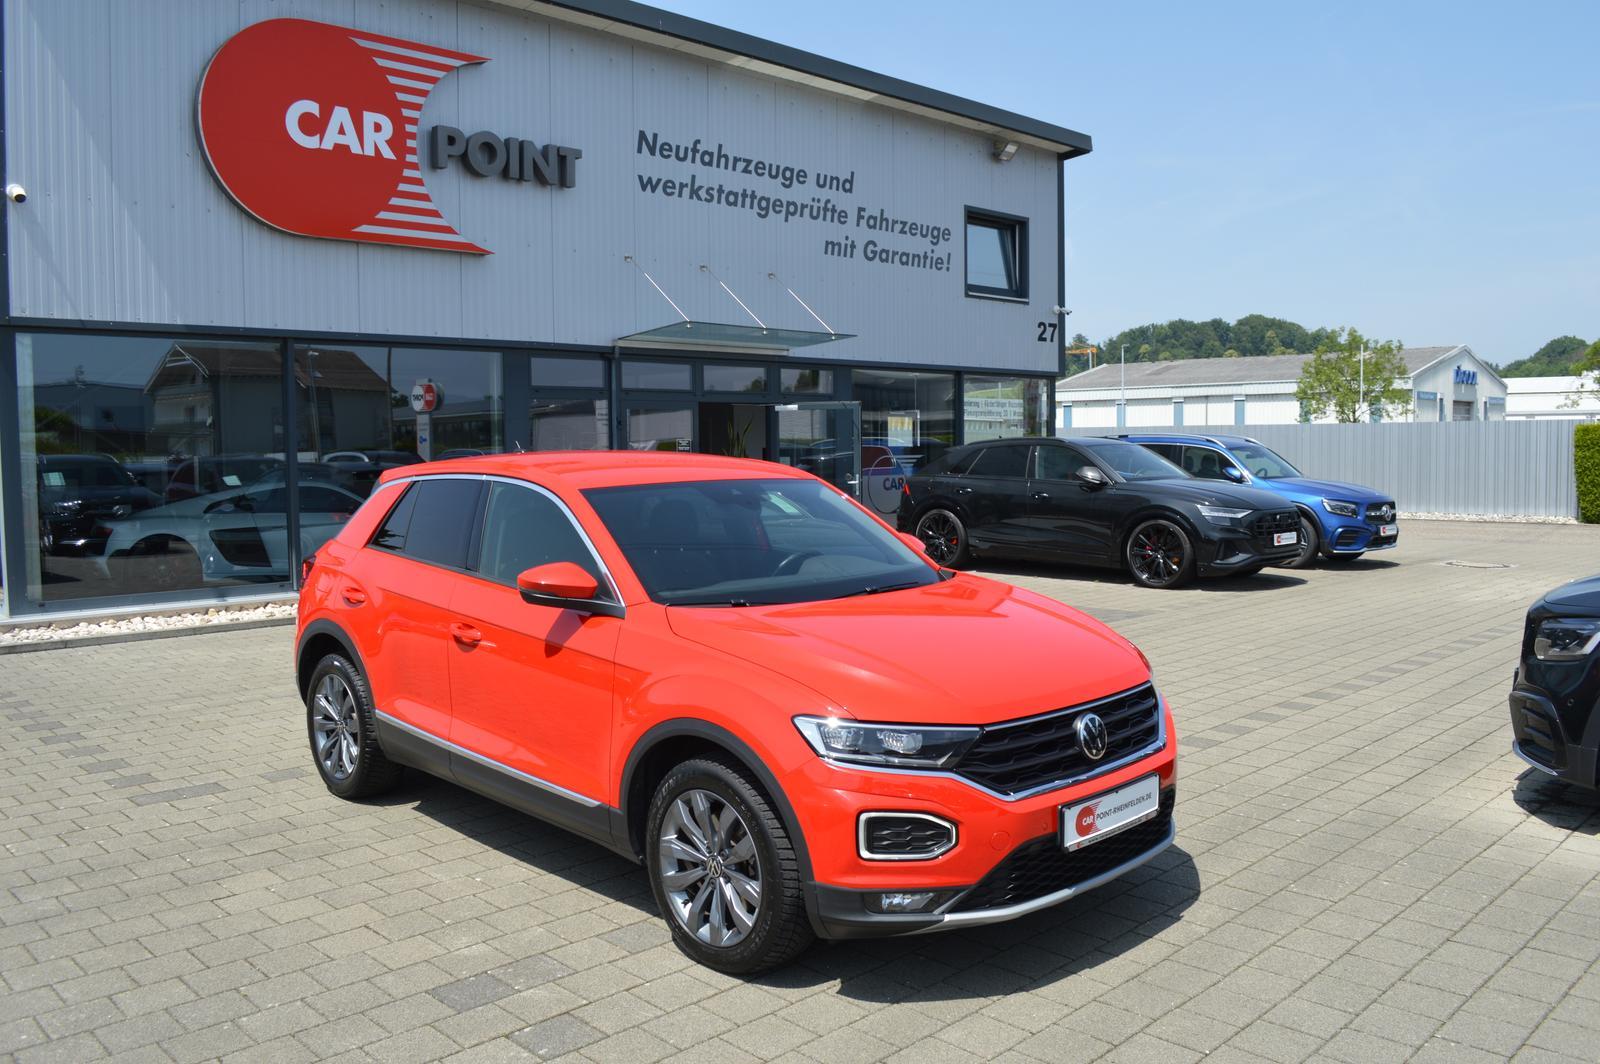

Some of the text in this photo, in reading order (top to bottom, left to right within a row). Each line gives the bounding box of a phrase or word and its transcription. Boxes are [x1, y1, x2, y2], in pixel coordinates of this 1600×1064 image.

[285, 100, 581, 188] CAR POINT
[637, 130, 854, 194] Neufahrzeuge und
[637, 173, 951, 245] werkstattgeprüfte Fahrzeuge
[824, 236, 951, 271] mit Garantie!
[1037, 322, 1057, 343] 27
[883, 477, 904, 491] CAR
[1082, 792, 1152, 825] CAR POINT-RHEINFELDEN.DE
